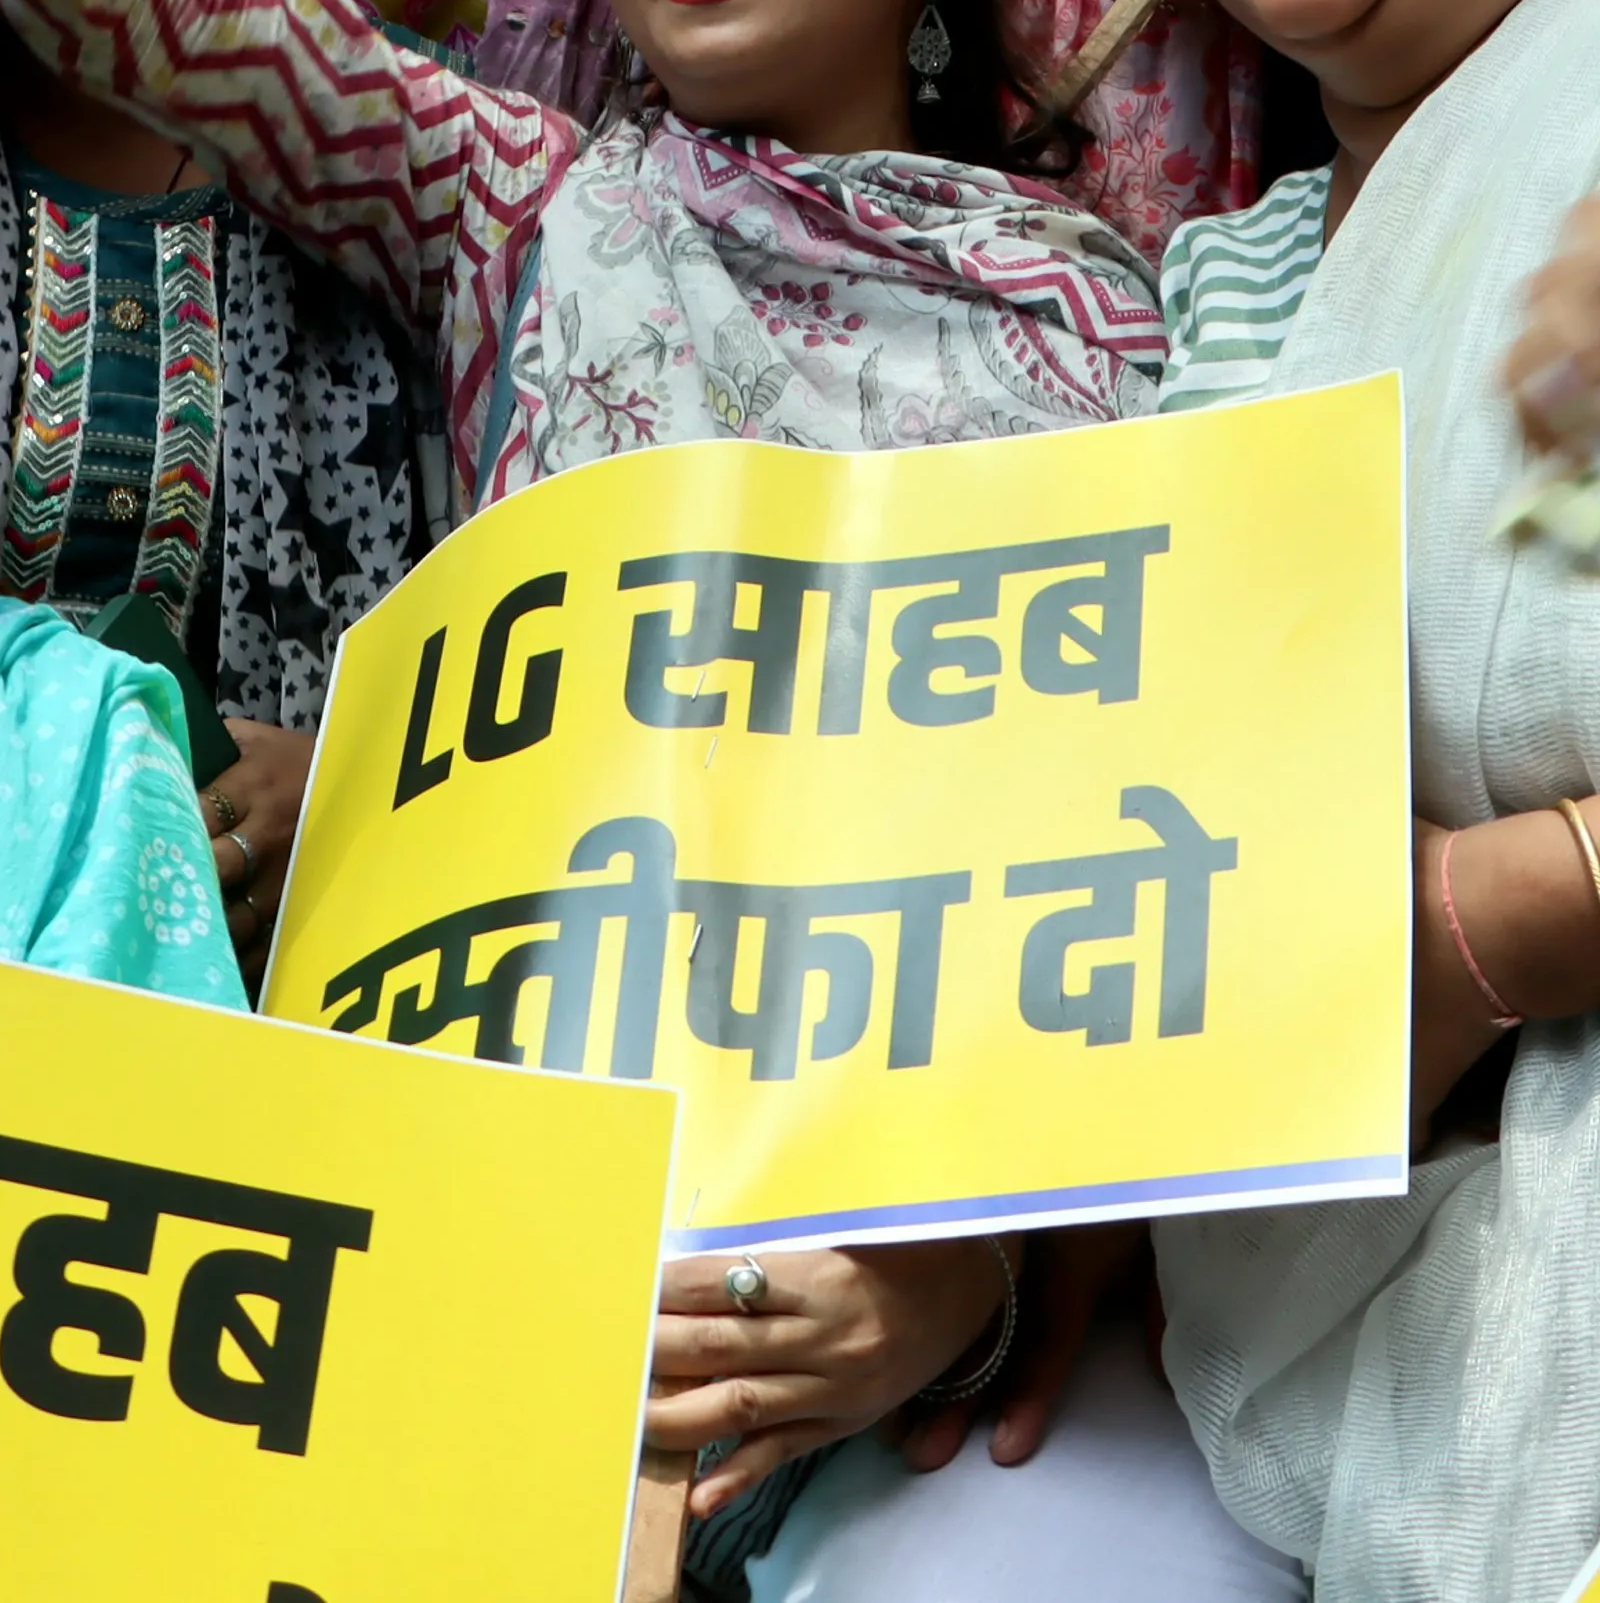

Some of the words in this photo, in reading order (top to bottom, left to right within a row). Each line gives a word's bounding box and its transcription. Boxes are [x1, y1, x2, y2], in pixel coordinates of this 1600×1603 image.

[393, 572, 567, 812] LG
[616, 524, 1171, 737] साहब
[1005, 785, 1238, 1047] दो
